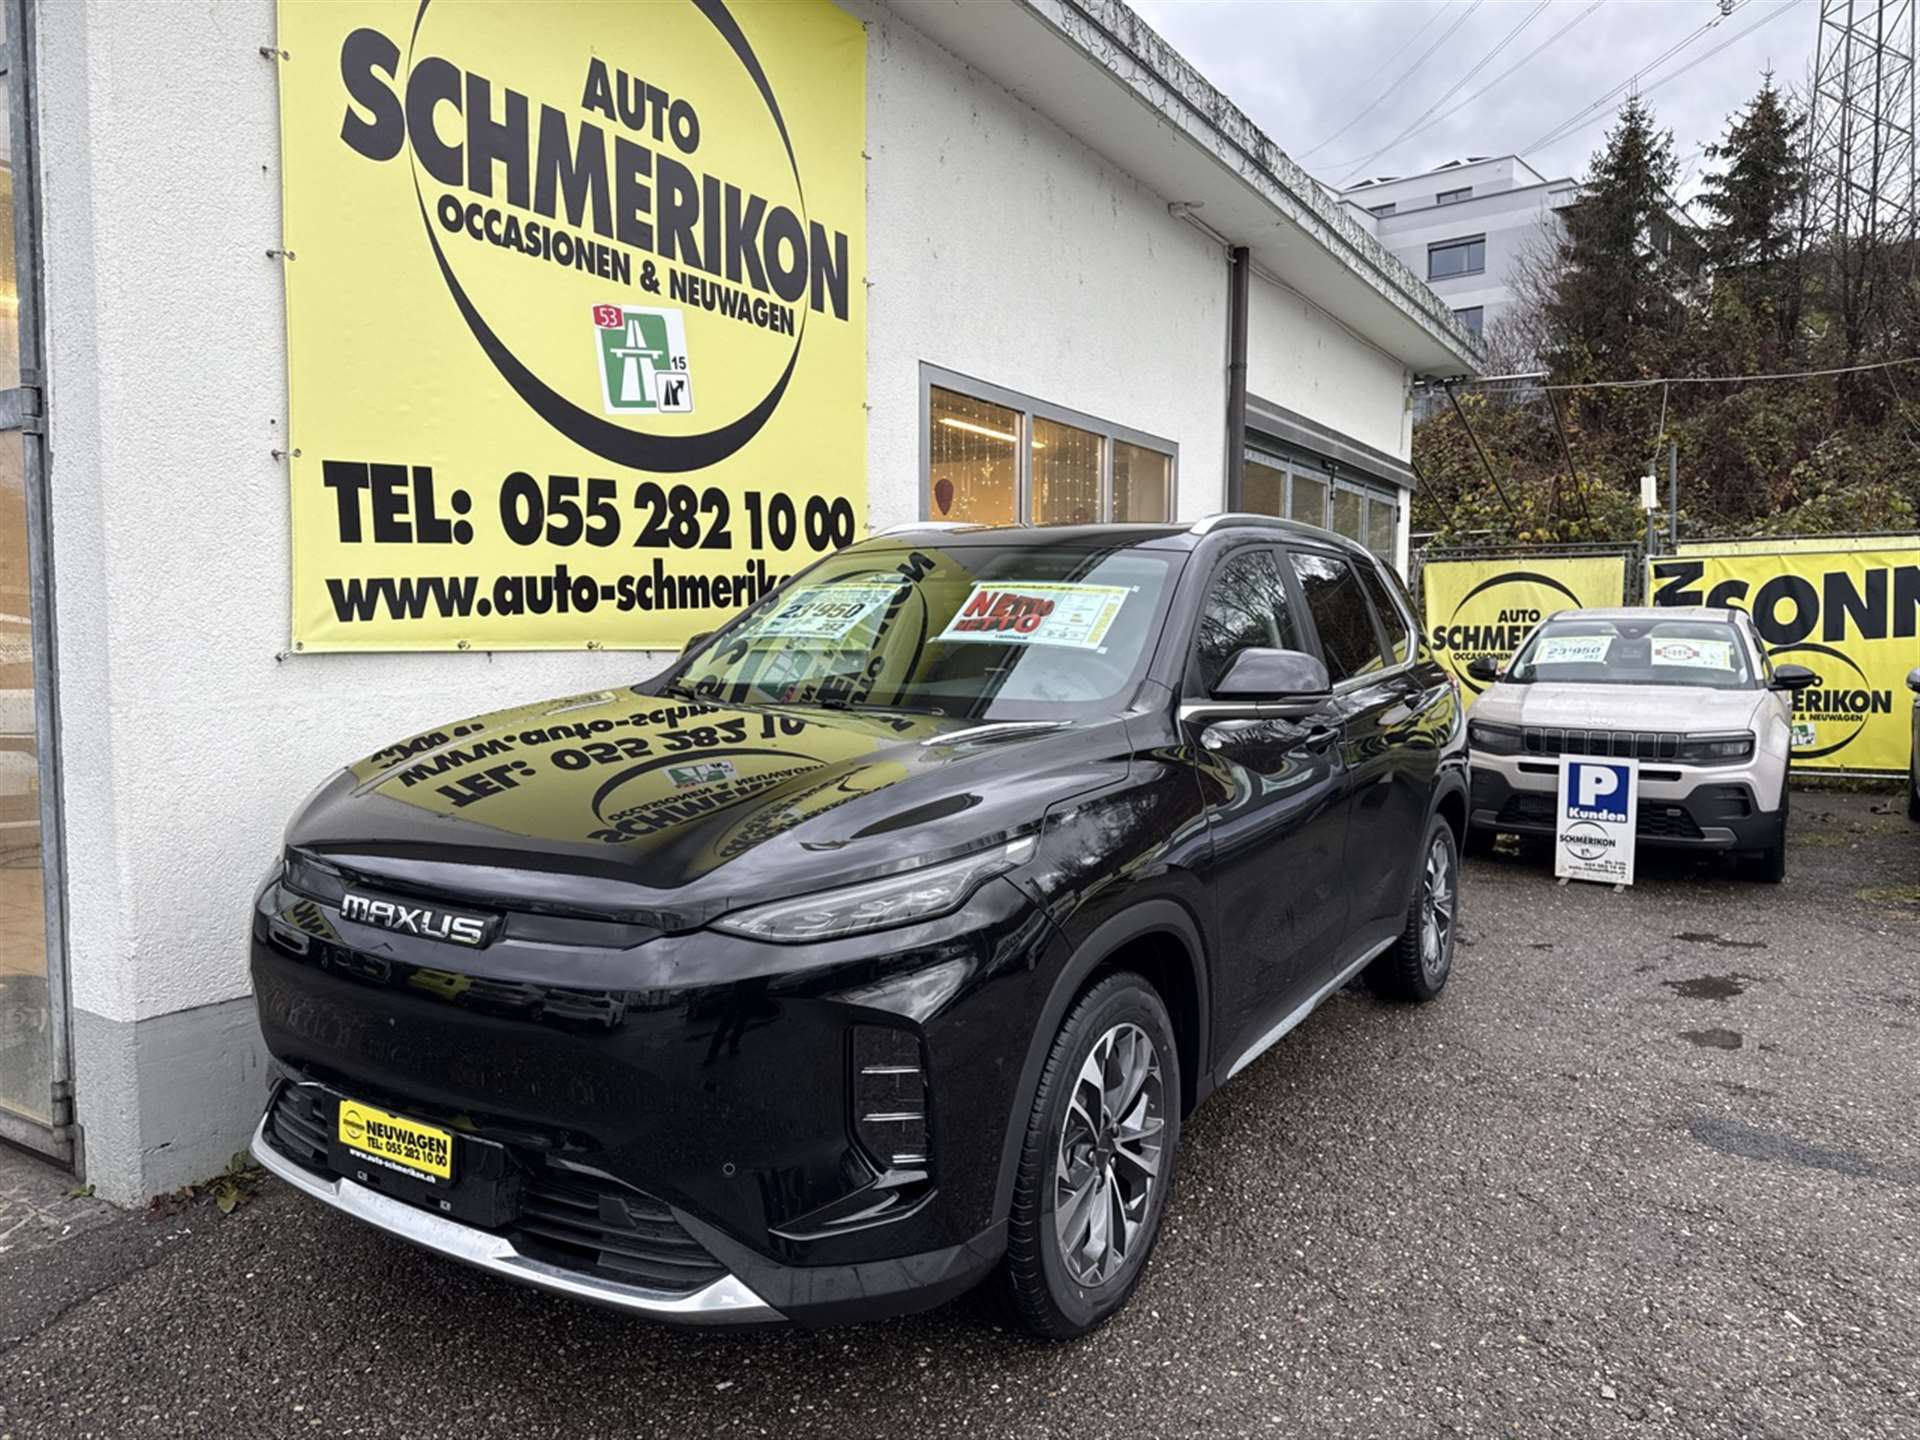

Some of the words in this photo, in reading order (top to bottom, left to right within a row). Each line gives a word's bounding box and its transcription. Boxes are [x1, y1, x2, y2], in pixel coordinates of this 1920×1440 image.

[581, 57, 700, 154] AUTO
[340, 27, 849, 321] SCHMERIKON
[437, 194, 631, 286] OCCASIONEN
[640, 260, 661, 295] &
[669, 268, 794, 337] NEUWAGEN
[599, 307, 618, 326] 53
[672, 356, 687, 370] 15
[322, 460, 474, 545] TEL:
[499, 471, 621, 546] 055
[633, 481, 731, 549] 282
[744, 491, 796, 551] 10
[804, 495, 855, 553] 00
[326, 558, 791, 622] www.auto-schmerik
[1498, 610, 1541, 623] AUTO
[1792, 690, 1892, 713] ERIKON
[1809, 714, 1863, 722] NEUWAGEN
[1579, 765, 1619, 806] P
[1568, 807, 1626, 822] Kunden
[1560, 834, 1616, 847] SCHMERIKON
[340, 893, 485, 947] MAXUS
[366, 1119, 448, 1156] NEUWAGEN
[367, 1136, 383, 1151] TEL:
[385, 1141, 402, 1155] 055
[404, 1145, 421, 1161] 282
[422, 1151, 434, 1164] 10
[434, 1154, 448, 1167] 00
